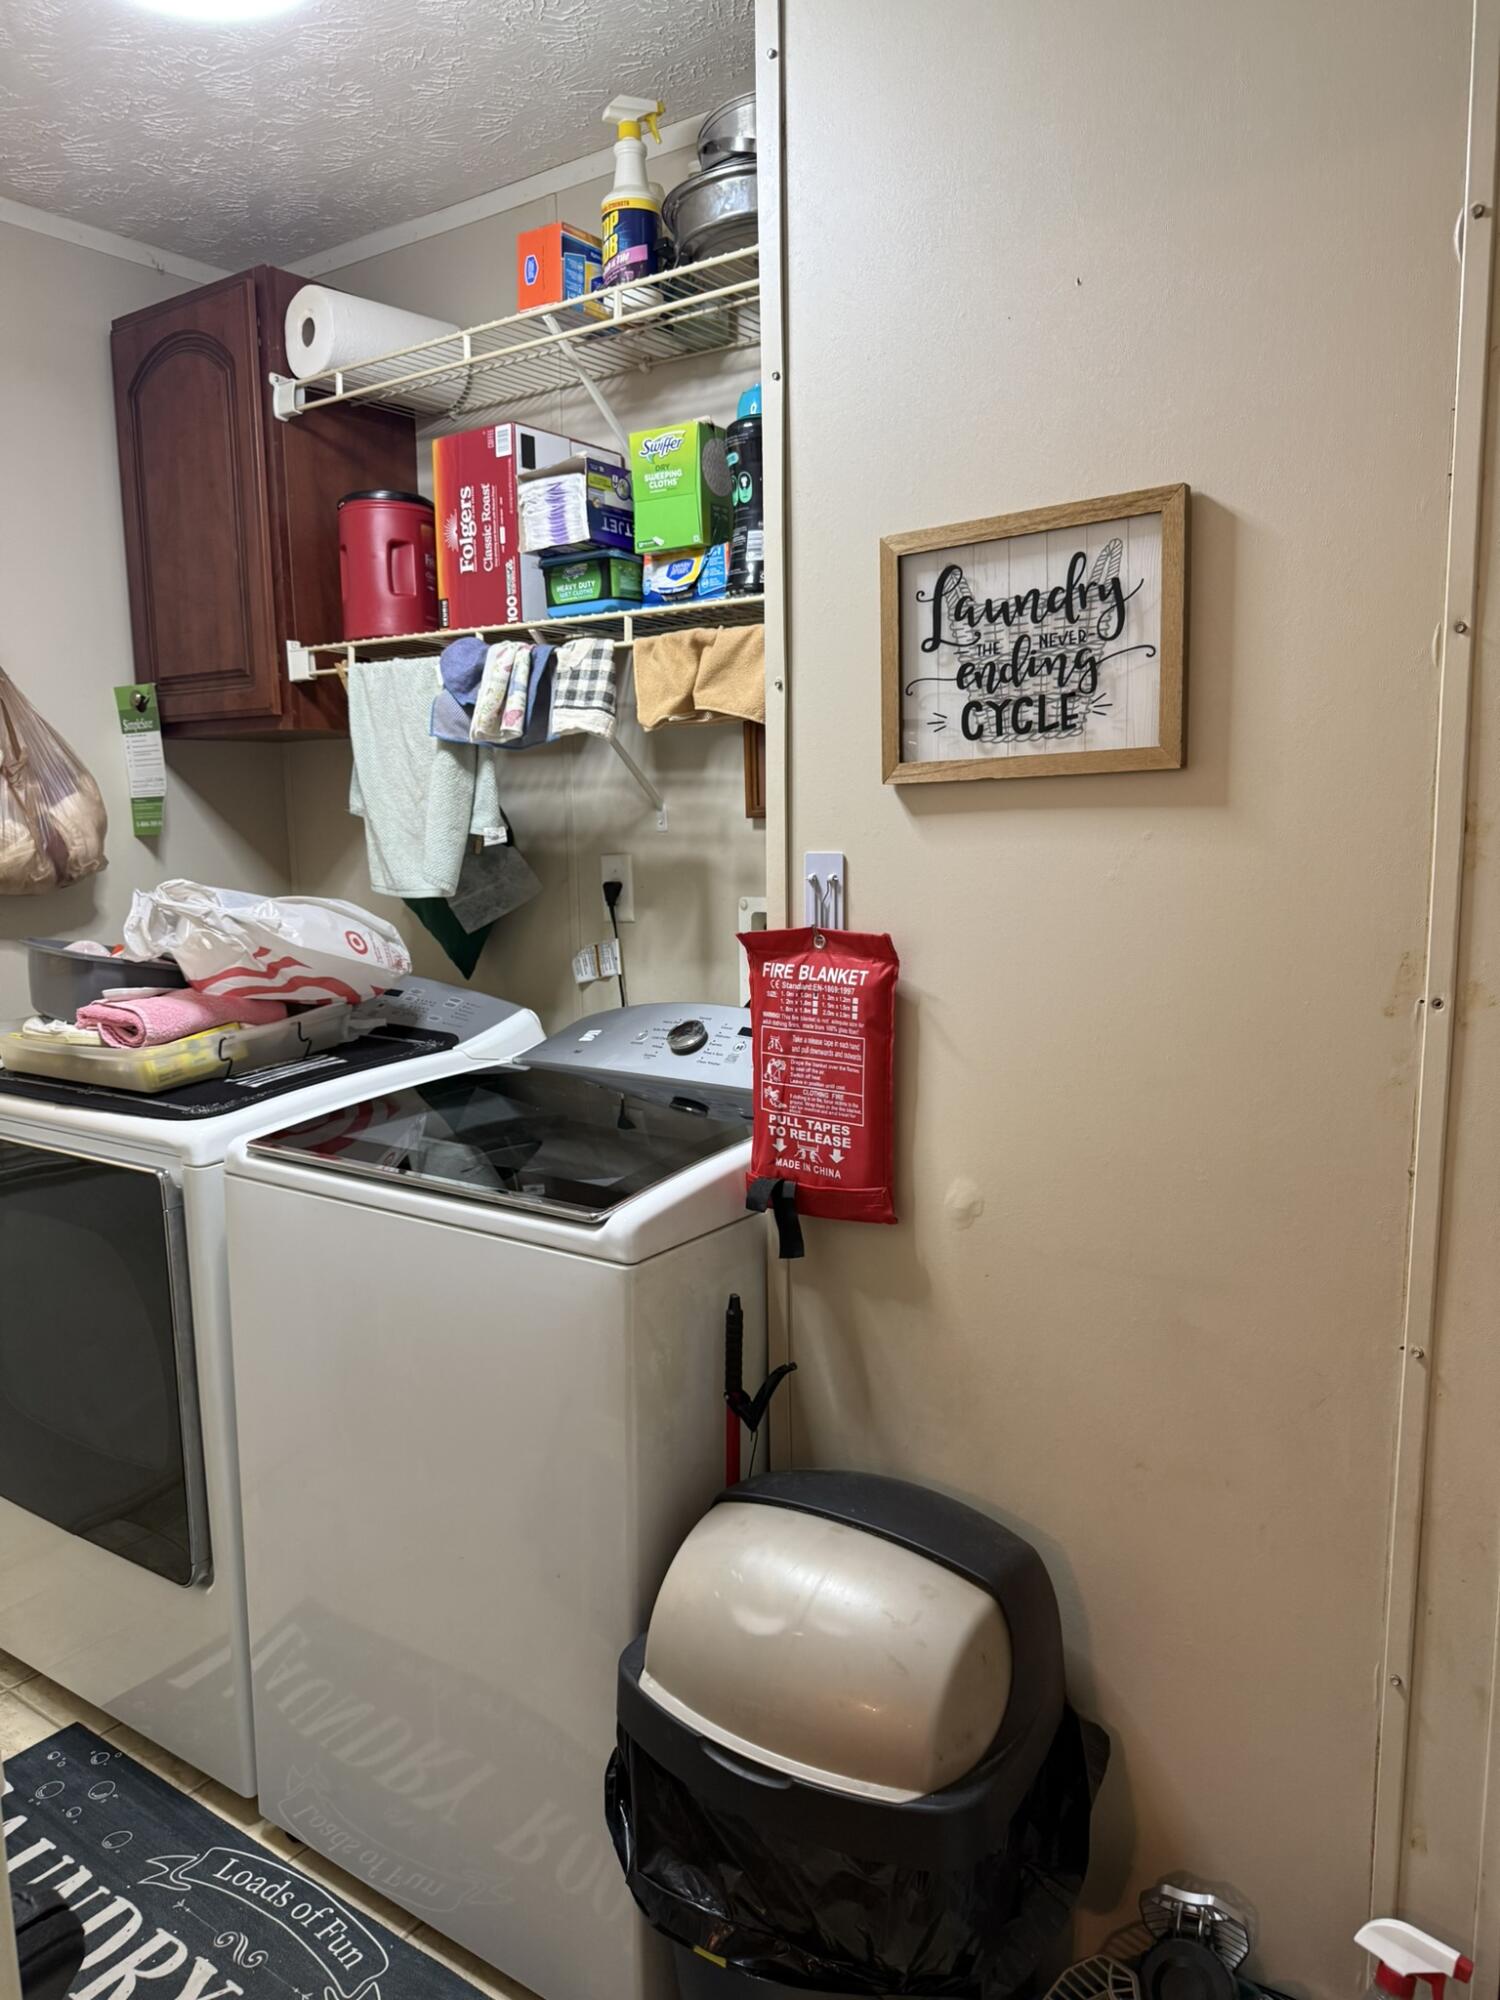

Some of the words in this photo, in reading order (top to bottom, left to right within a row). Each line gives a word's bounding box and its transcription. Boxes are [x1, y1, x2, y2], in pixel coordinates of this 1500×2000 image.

[640, 435, 683, 457] Swiffer
[644, 470, 683, 482] SWEEPING
[655, 464, 670, 472] DRY
[649, 479, 678, 489] CLOTHS
[480, 483, 492, 517] Roast
[459, 486, 477, 574] Folgers
[482, 519, 494, 572] Classic
[556, 582, 578, 592] HEAVY
[579, 580, 596, 590] DUTY
[506, 596, 518, 623] 100
[916, 551, 1144, 652] Laundry
[976, 643, 1000, 656] THE
[961, 692, 1078, 741] CYCLE
[762, 962, 795, 979] FIRE
[799, 965, 869, 986] BLANKET
[768, 1114, 802, 1128] PULL
[806, 1119, 850, 1135] TAPES
[768, 1126, 786, 1137] TO
[790, 1130, 851, 1149] RELEASE
[775, 1158, 800, 1170] MADE
[802, 1163, 811, 1172] IN
[814, 1165, 841, 1179] CHINA
[212, 1856, 296, 1908] Loads
[290, 1902, 335, 1929] of
[313, 1916, 365, 1971] Fun
